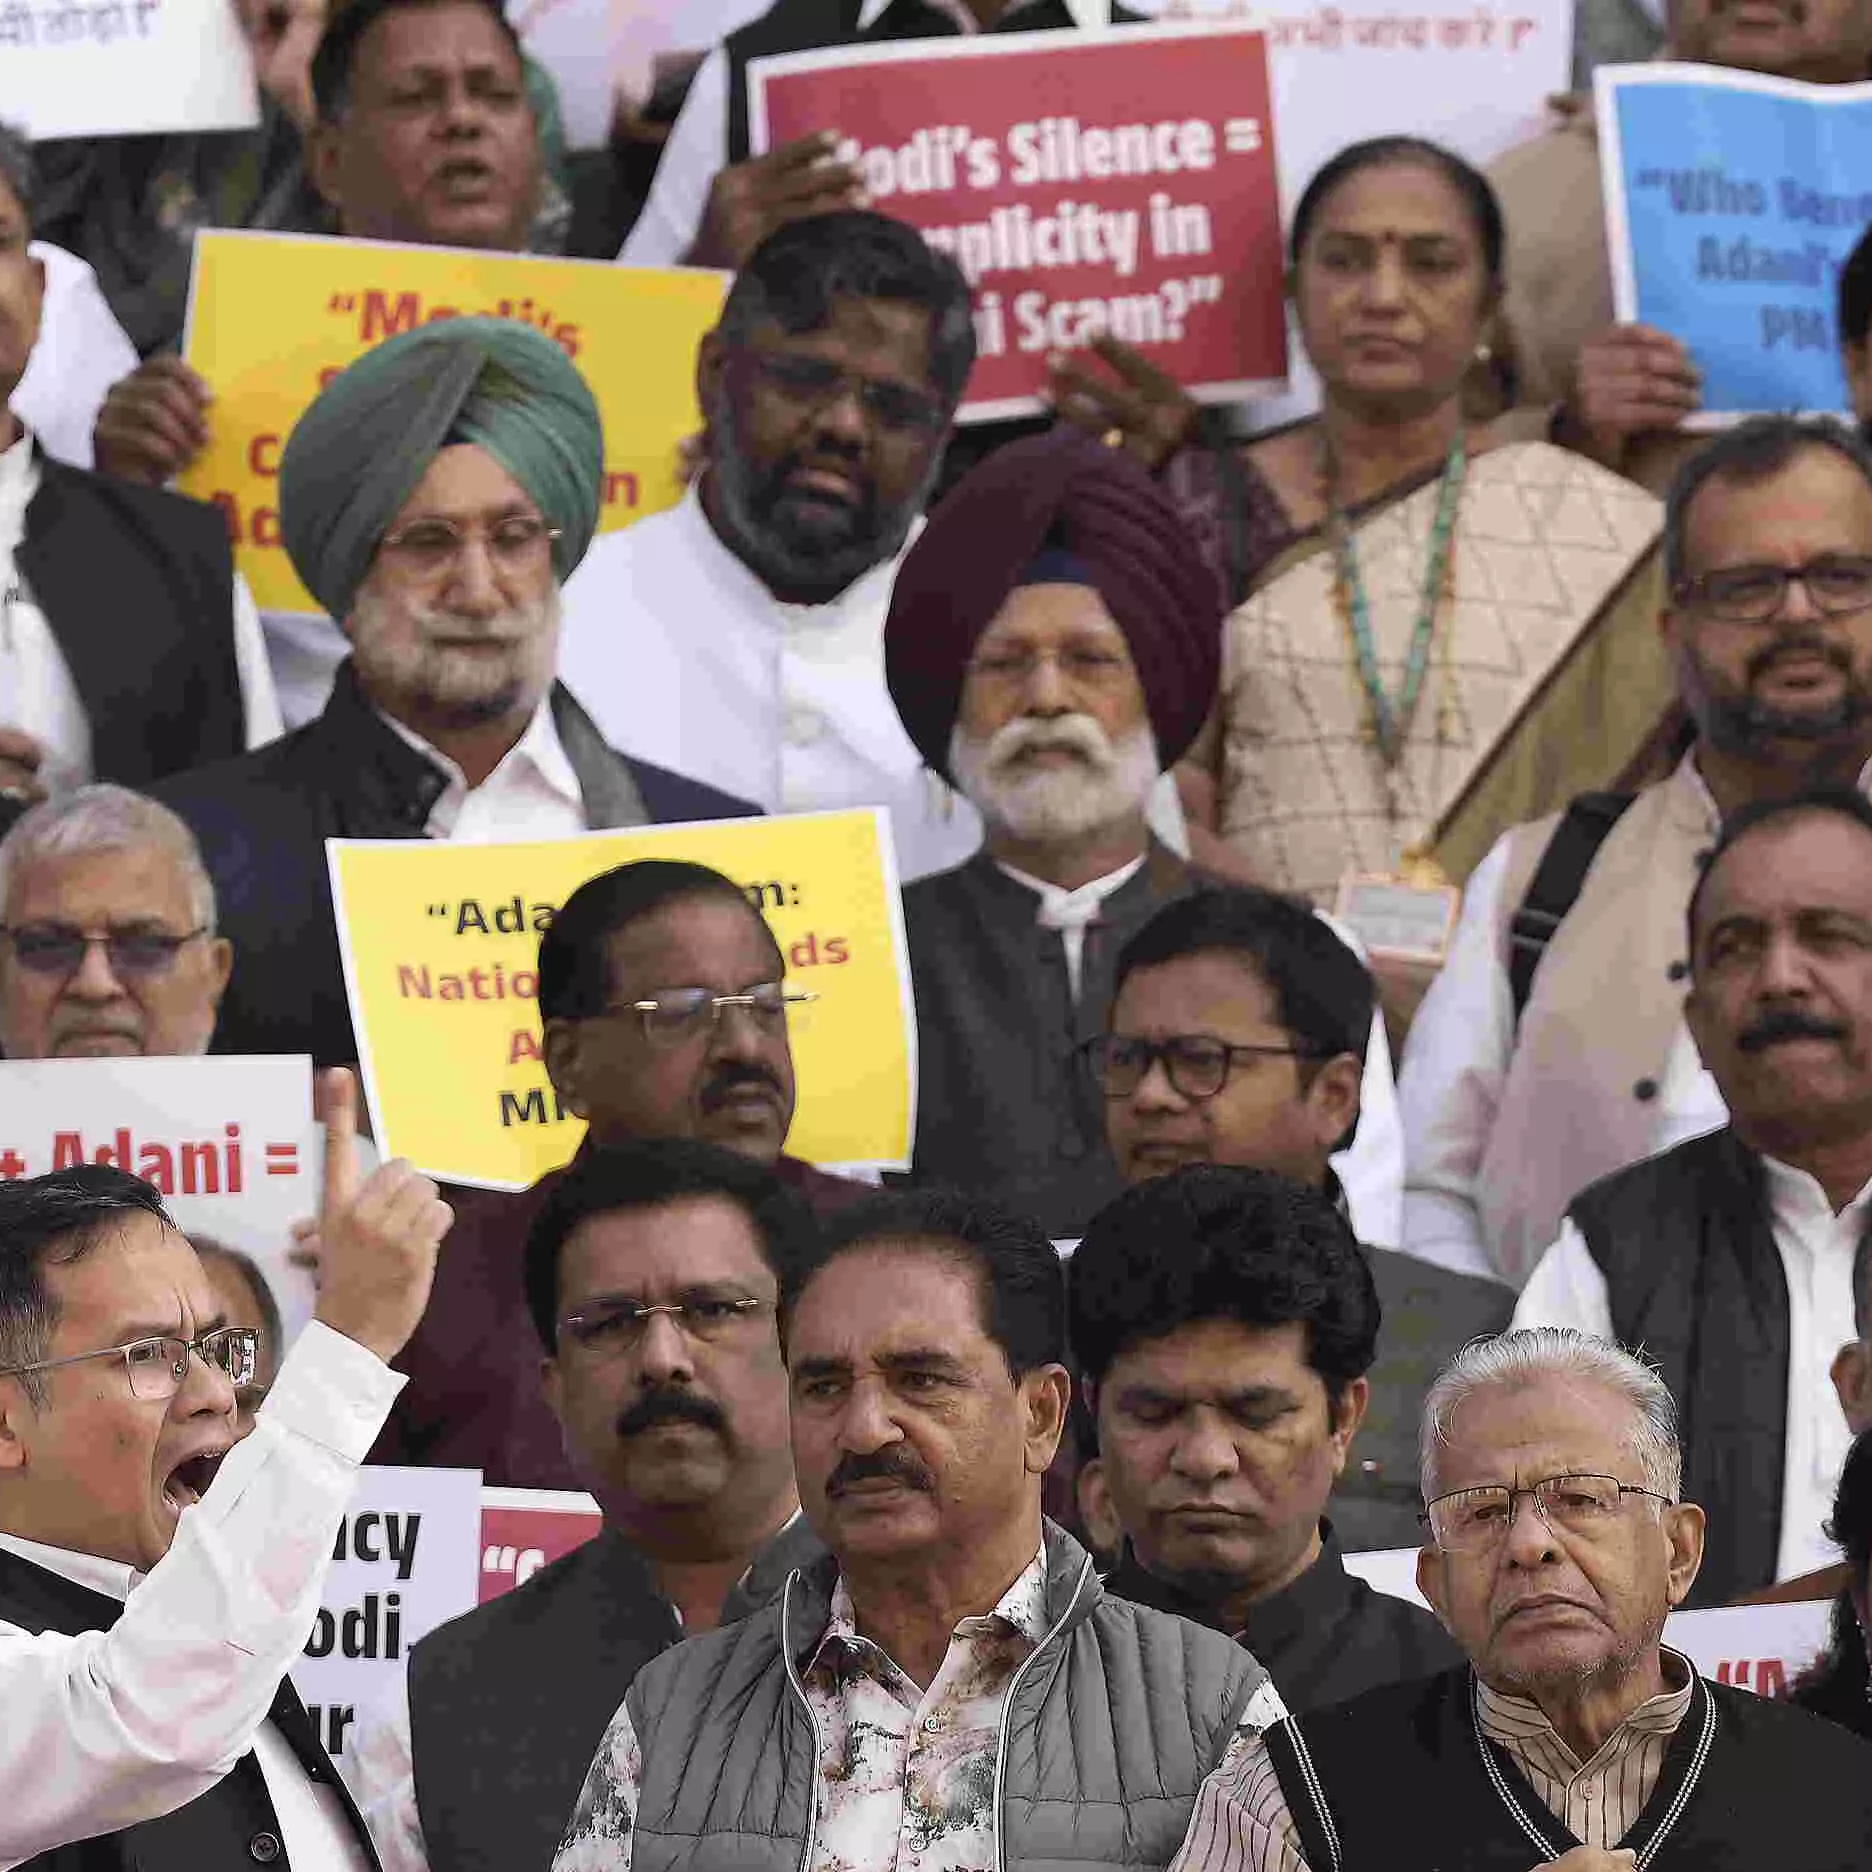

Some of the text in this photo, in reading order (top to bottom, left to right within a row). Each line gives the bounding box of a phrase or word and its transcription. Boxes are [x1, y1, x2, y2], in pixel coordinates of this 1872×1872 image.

[1007, 116, 1215, 186] Silence
[1224, 117, 1262, 152] =
[921, 192, 1210, 288] plicity in
[264, 1142, 299, 1176] =
